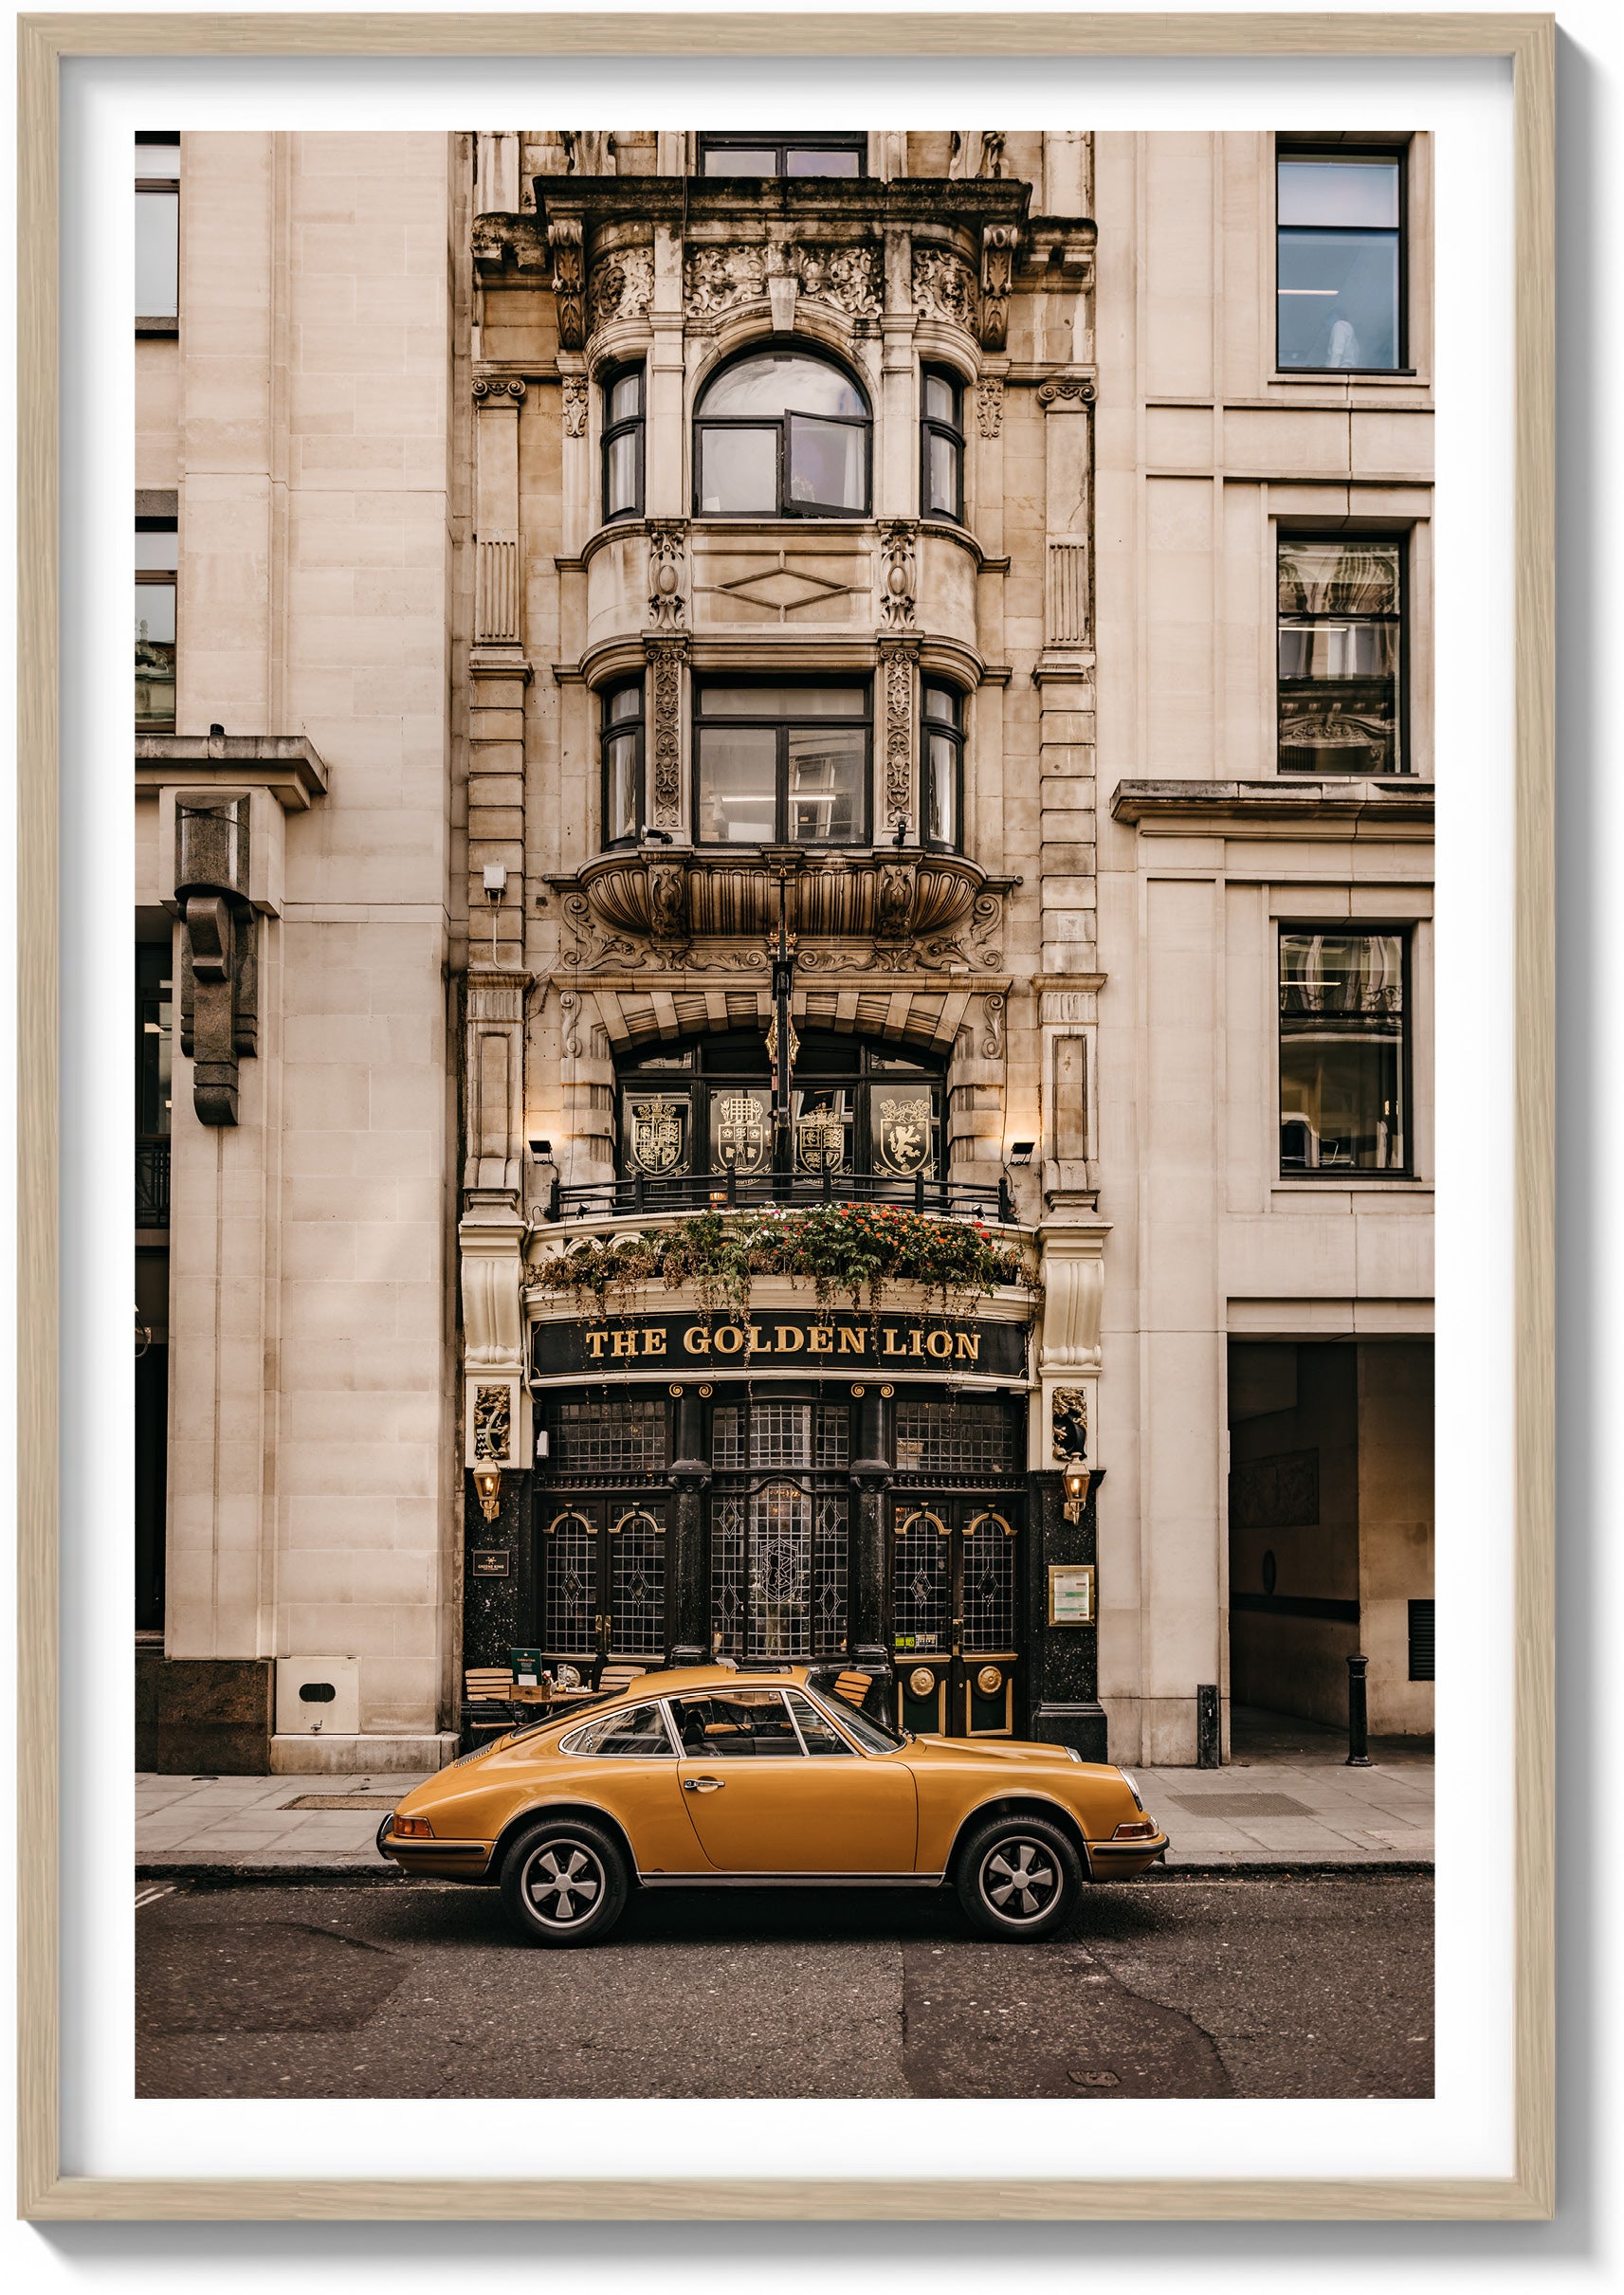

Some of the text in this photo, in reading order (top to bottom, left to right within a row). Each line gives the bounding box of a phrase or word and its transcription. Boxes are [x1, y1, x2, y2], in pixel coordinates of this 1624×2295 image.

[586, 1325, 981, 1359] THE GOLDEN LION
